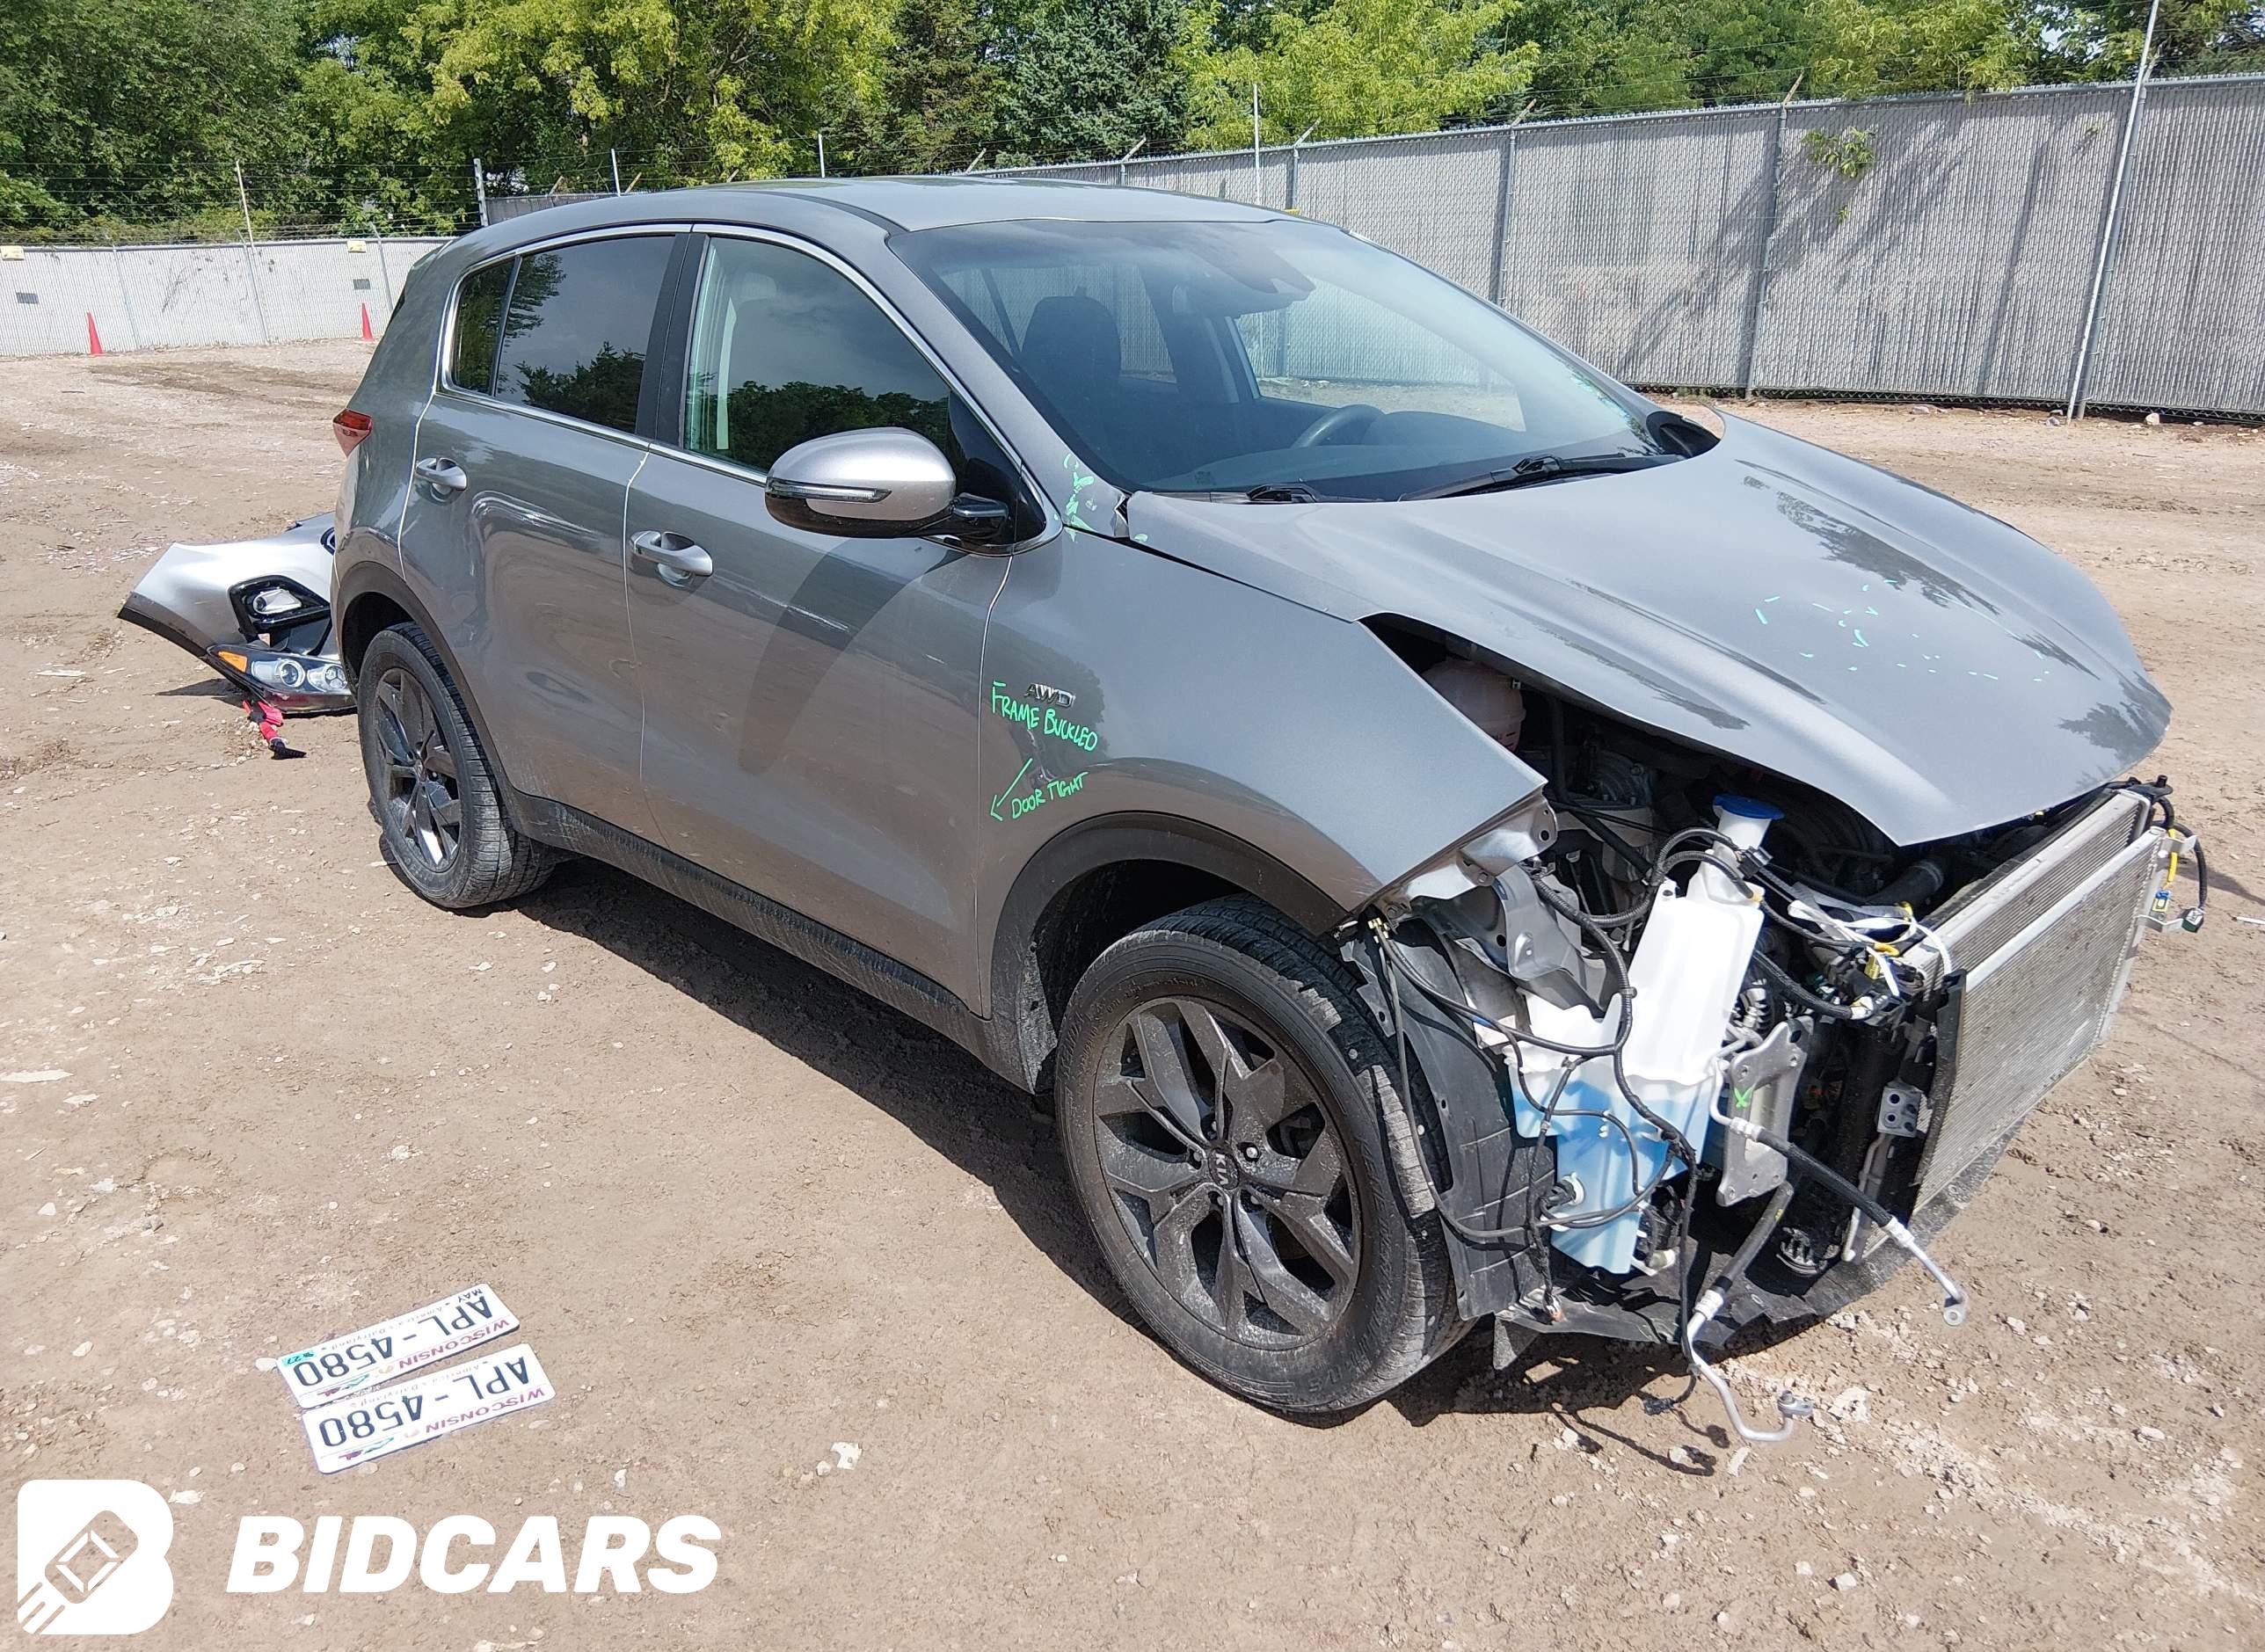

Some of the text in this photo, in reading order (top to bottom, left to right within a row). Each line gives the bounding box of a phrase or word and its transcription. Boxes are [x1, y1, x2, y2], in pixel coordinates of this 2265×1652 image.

[992, 680, 1040, 729] FRAME
[1024, 683, 1075, 707] AWD
[1012, 772, 1089, 819] DOOR TIGHT
[1215, 1153, 1228, 1184] KIA
[457, 1288, 483, 1303] MAY
[398, 1320, 510, 1369] WISCONSIN
[426, 1388, 544, 1433] WISCONSIN
